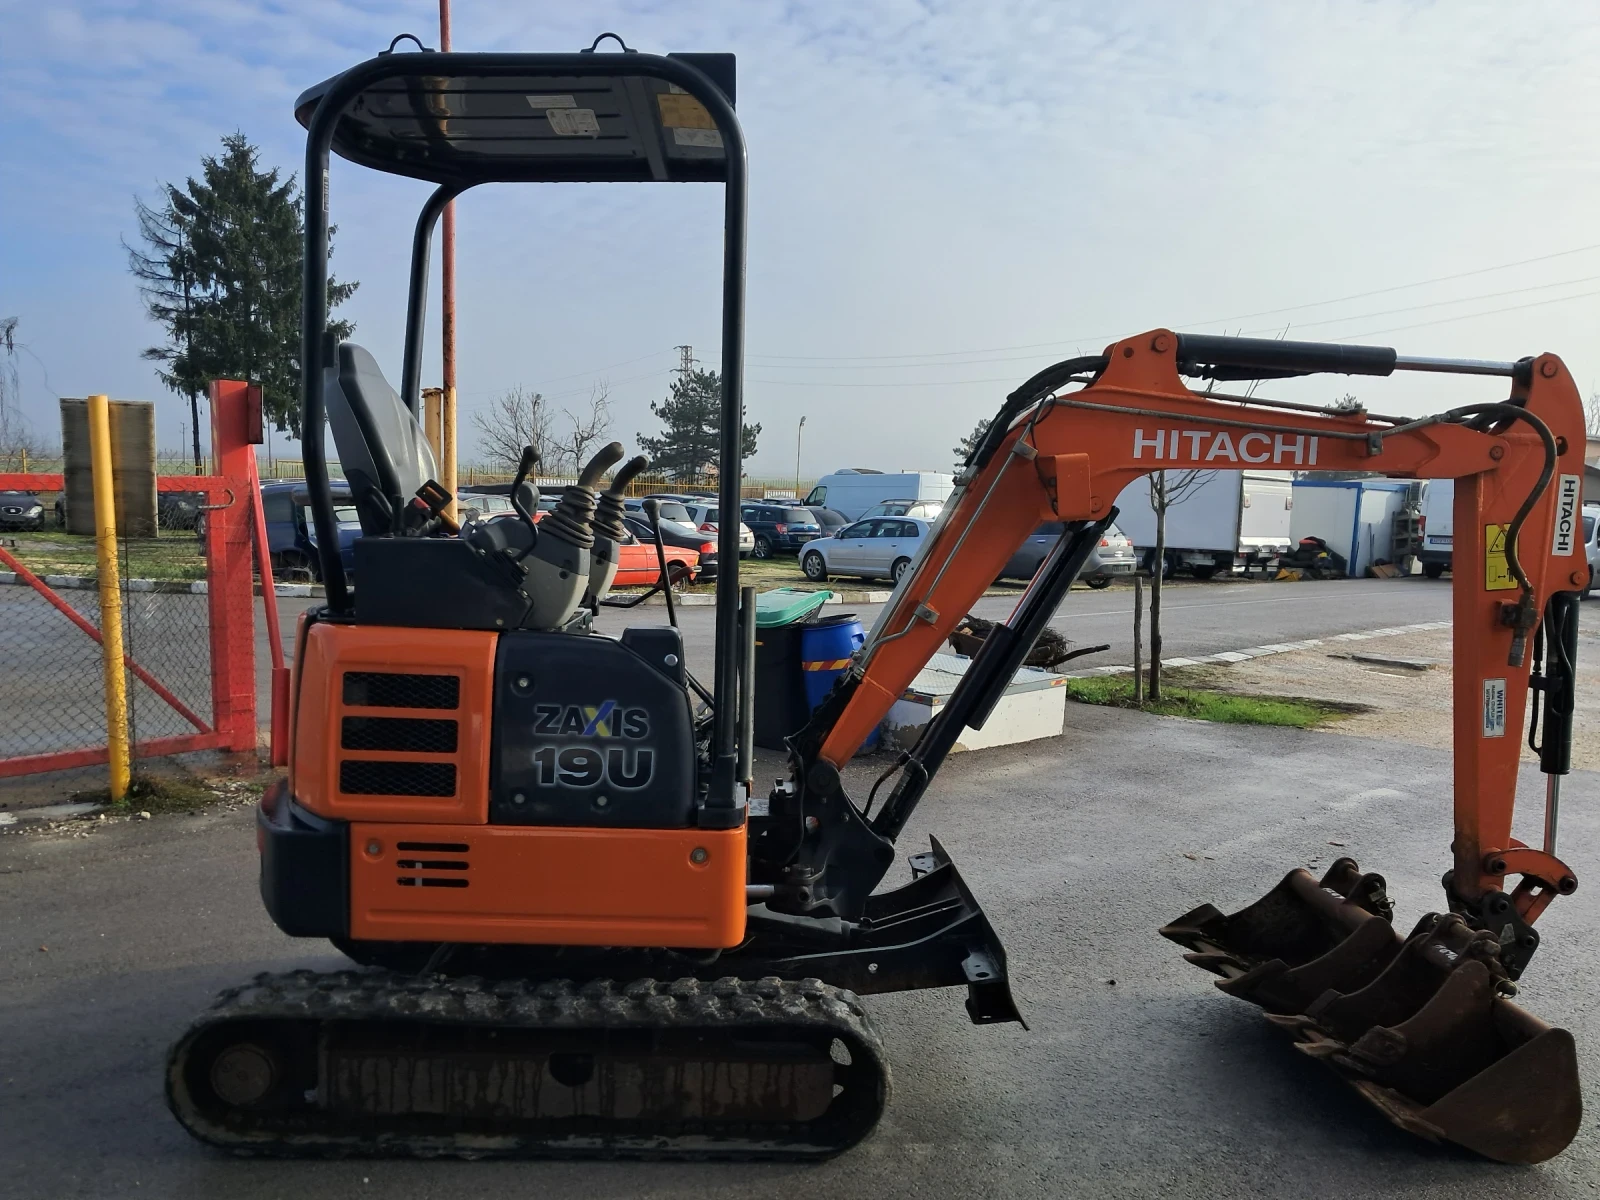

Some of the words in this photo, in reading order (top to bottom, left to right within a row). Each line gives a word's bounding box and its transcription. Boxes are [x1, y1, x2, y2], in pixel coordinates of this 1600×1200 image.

[1133, 428, 1319, 466] HITACHI
[1557, 479, 1576, 551] HITACHI
[534, 700, 650, 740] ZAXIS
[533, 746, 655, 789] 19U
